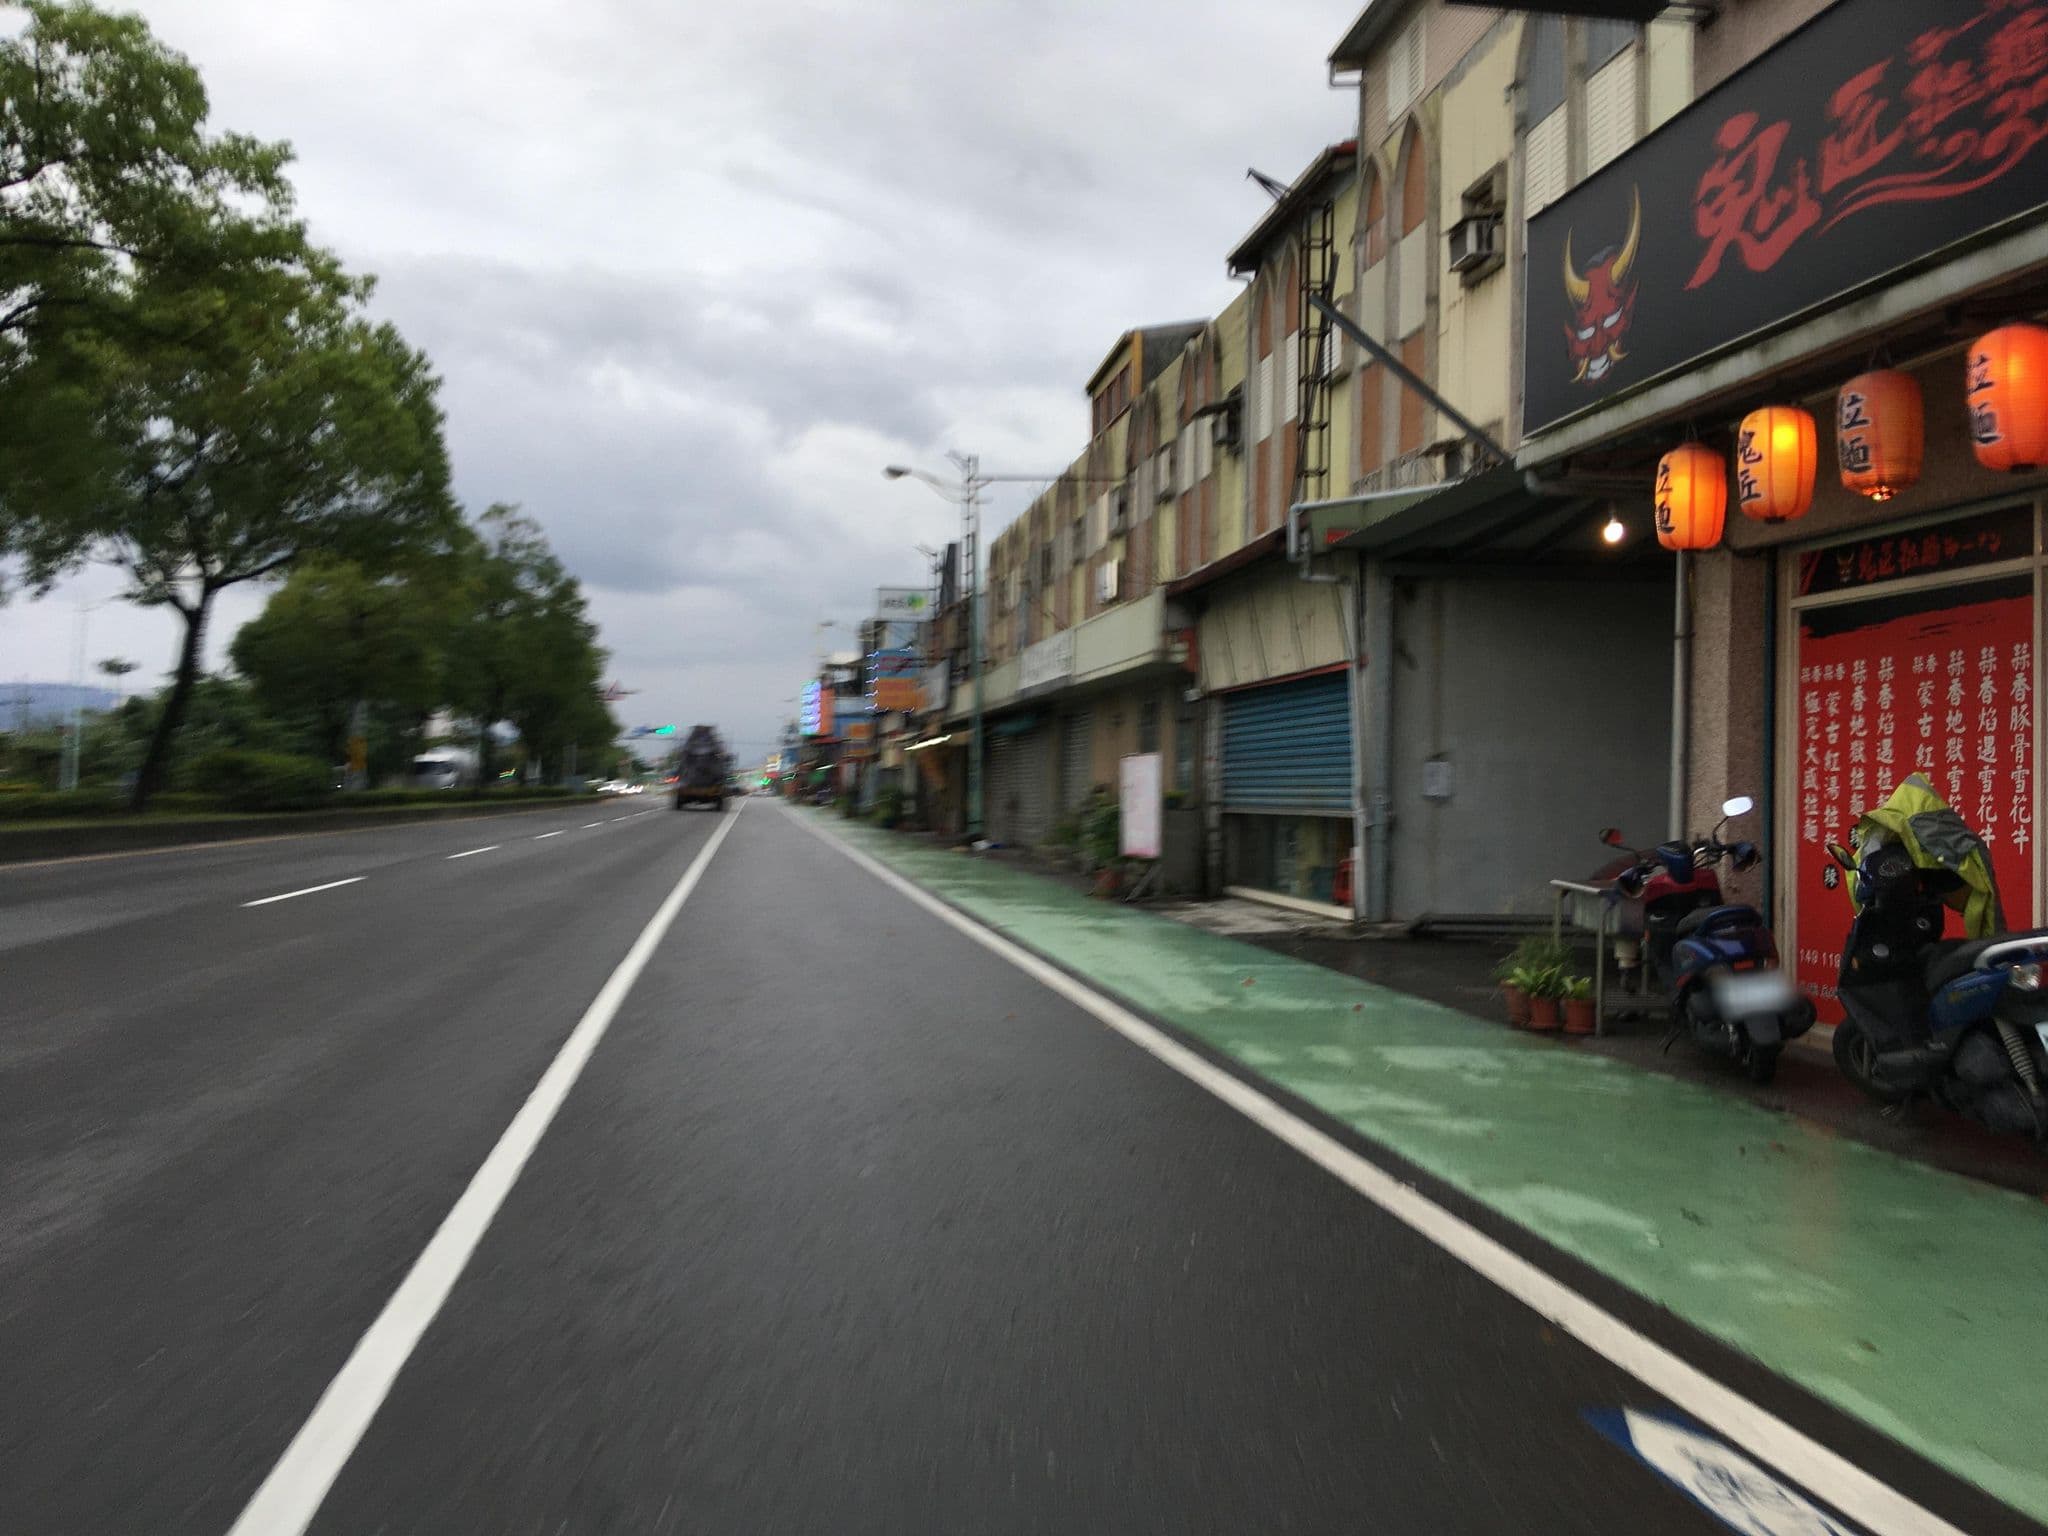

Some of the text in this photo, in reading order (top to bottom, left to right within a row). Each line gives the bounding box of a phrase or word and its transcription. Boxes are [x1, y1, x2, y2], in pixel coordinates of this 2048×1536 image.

[2009, 642, 2032, 857] 蒜香豚骨雪花牛
